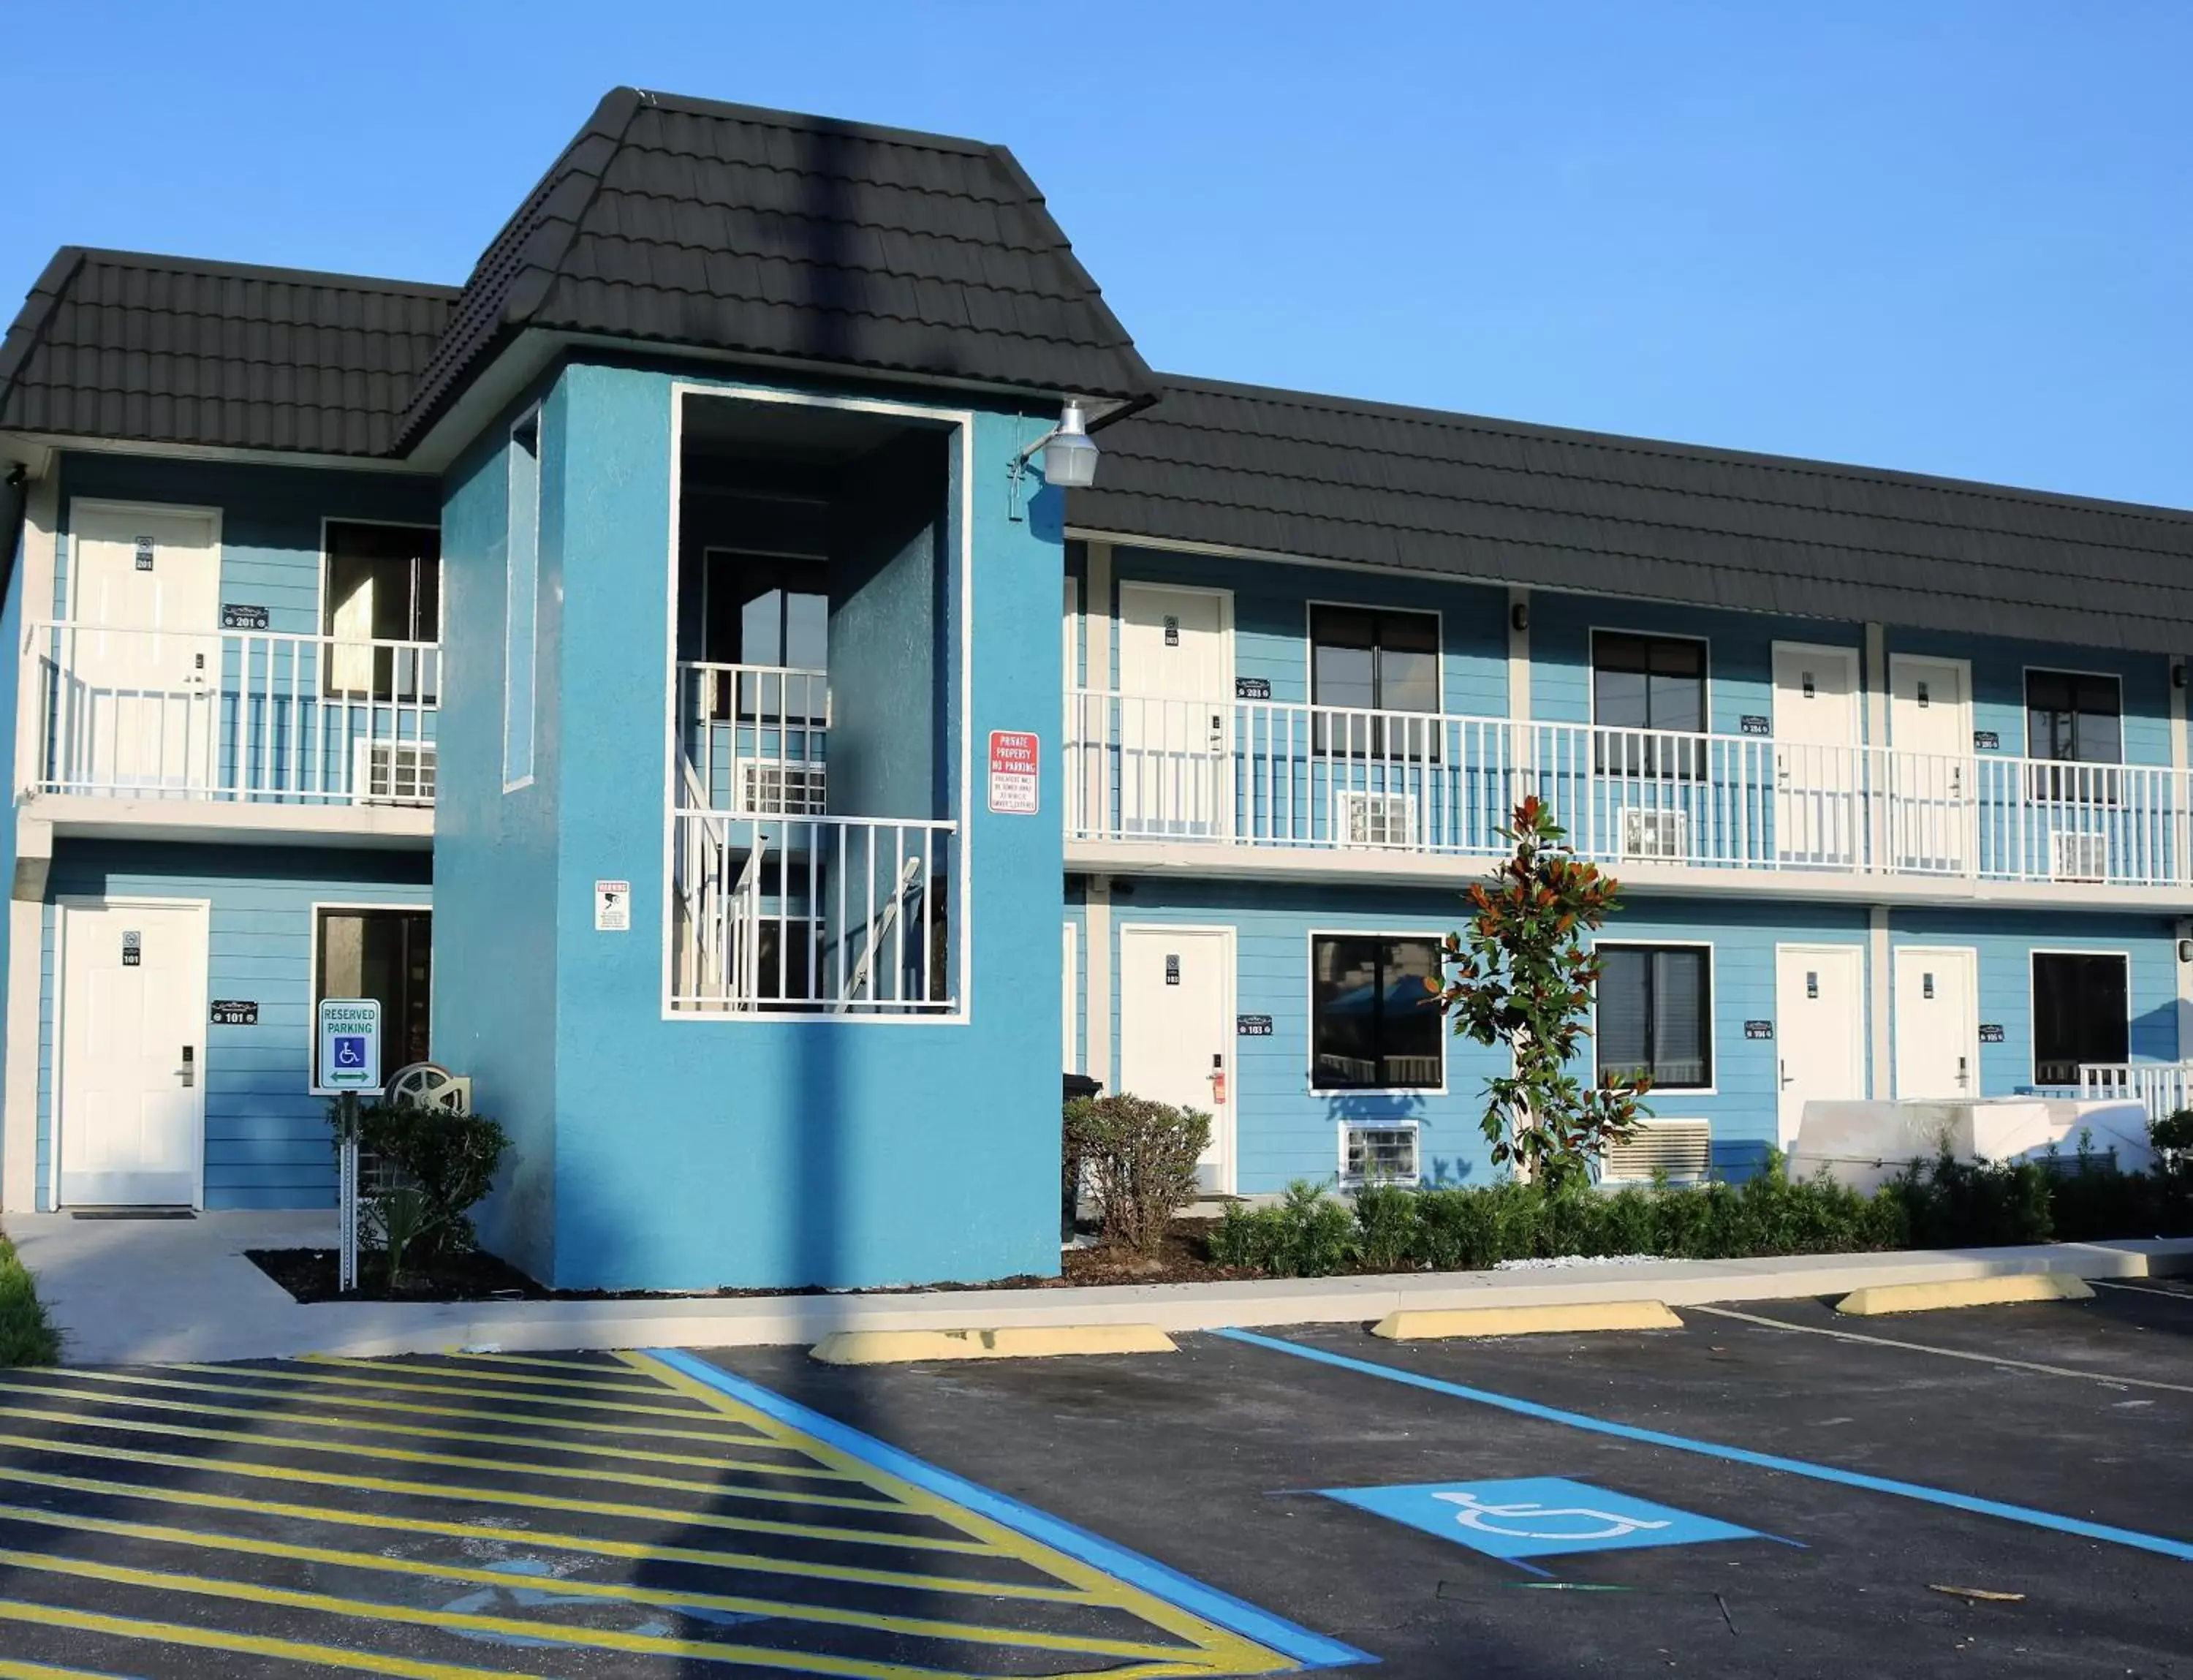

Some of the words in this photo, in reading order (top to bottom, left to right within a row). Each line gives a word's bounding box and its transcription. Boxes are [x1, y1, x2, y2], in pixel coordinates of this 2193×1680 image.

[237, 616, 254, 627] 201
[1000, 735, 1029, 747] PRIVATE
[996, 747, 1031, 760] PROPERTY
[992, 760, 1002, 771] NO
[1005, 761, 1036, 773] PARKING
[124, 955, 138, 964] 101
[226, 1013, 243, 1023] 101
[324, 1009, 375, 1021] RESERVED
[327, 1023, 372, 1033] PARKING
[1249, 1026, 1262, 1034] 103
